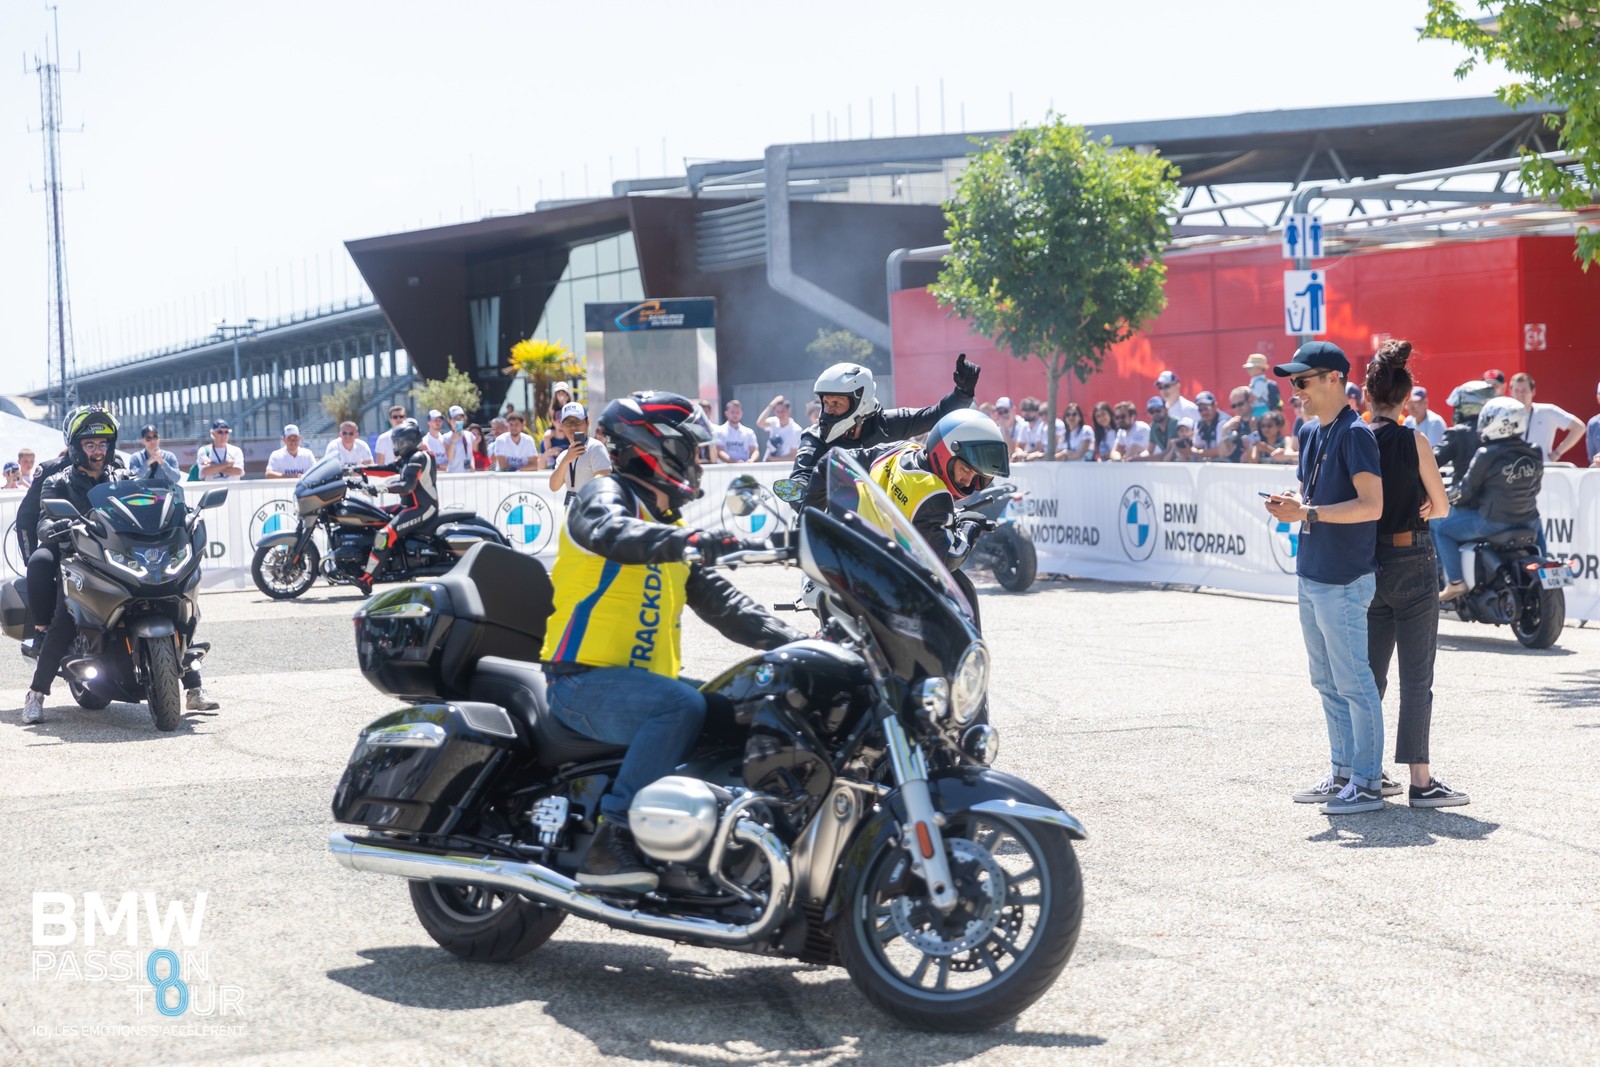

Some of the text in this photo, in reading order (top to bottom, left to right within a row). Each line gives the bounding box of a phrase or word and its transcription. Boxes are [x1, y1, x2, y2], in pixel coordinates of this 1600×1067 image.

[1163, 503, 1198, 524] BMW
[1030, 524, 1100, 546] MOTORRAD
[1165, 530, 1246, 556] MOTORRAD
